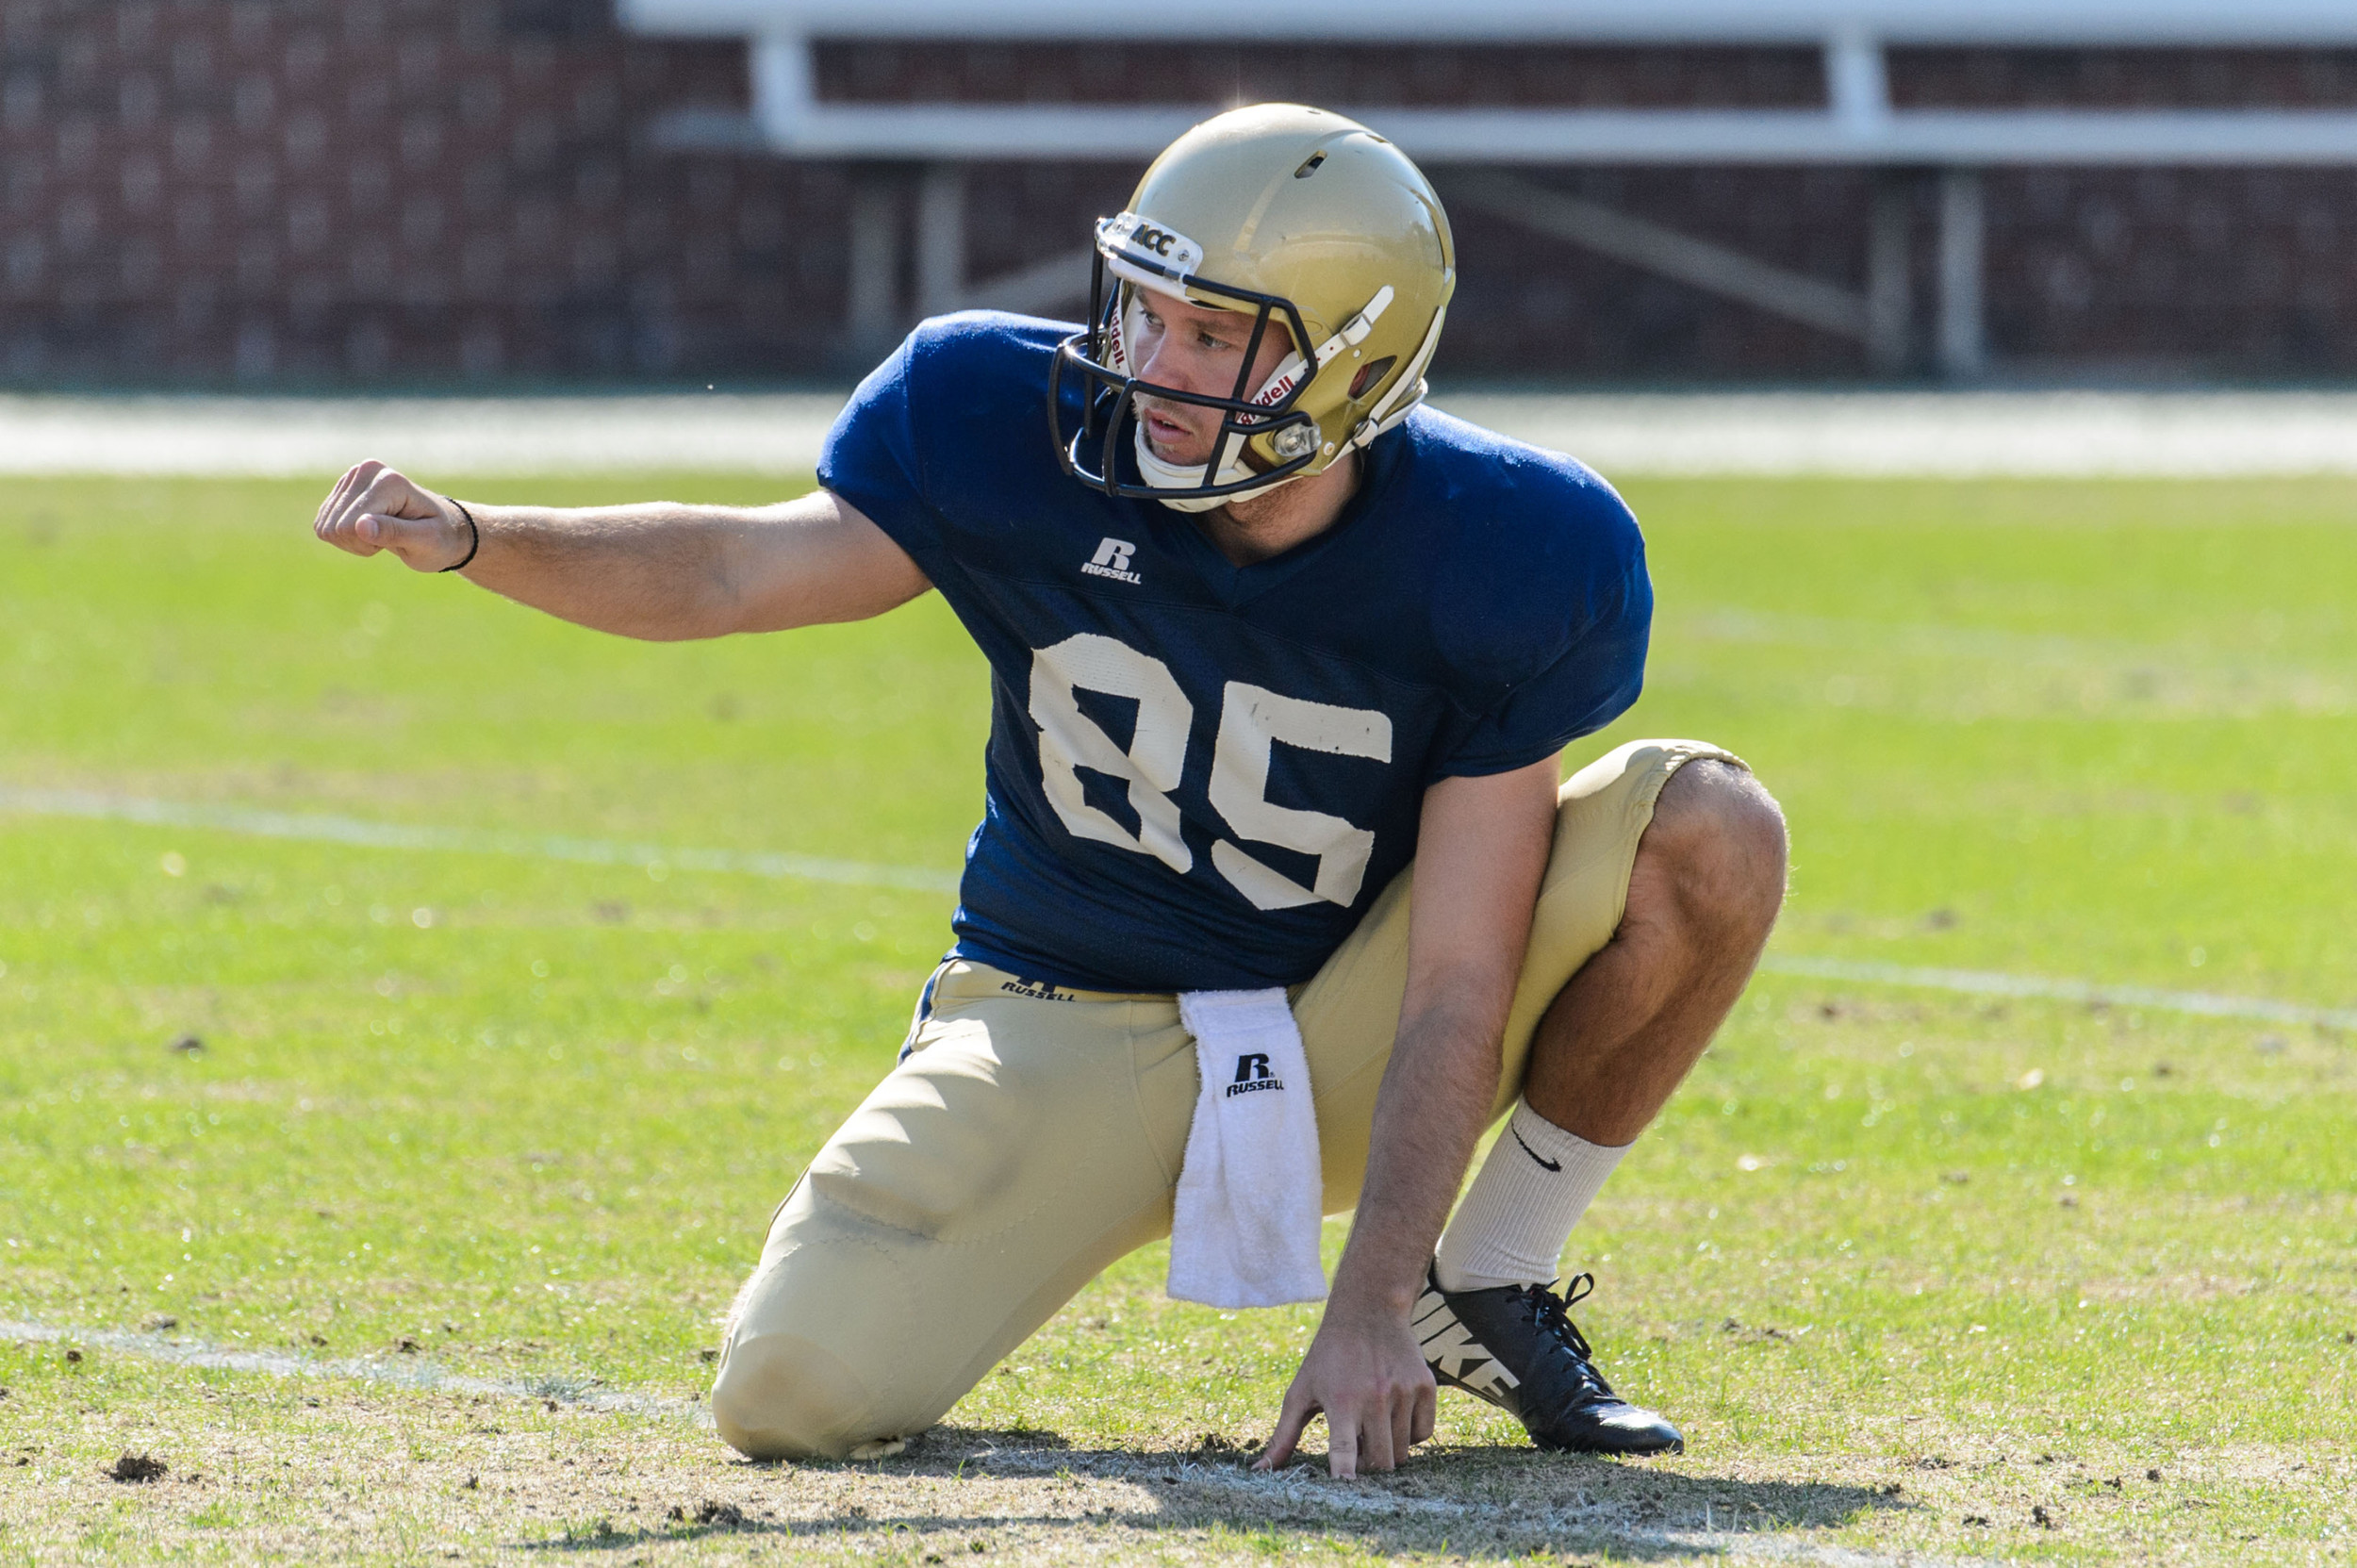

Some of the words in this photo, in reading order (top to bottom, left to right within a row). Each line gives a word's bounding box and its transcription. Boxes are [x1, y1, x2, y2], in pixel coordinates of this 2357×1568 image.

[1130, 223, 1177, 256] ACC
[1091, 537, 1136, 571] R
[1080, 562, 1141, 585] RUSSELL
[1029, 633, 1393, 911] 85
[1000, 982, 1076, 1002] RUSSELL
[1234, 1053, 1269, 1082] R
[1227, 1080, 1284, 1098] RUSSELL
